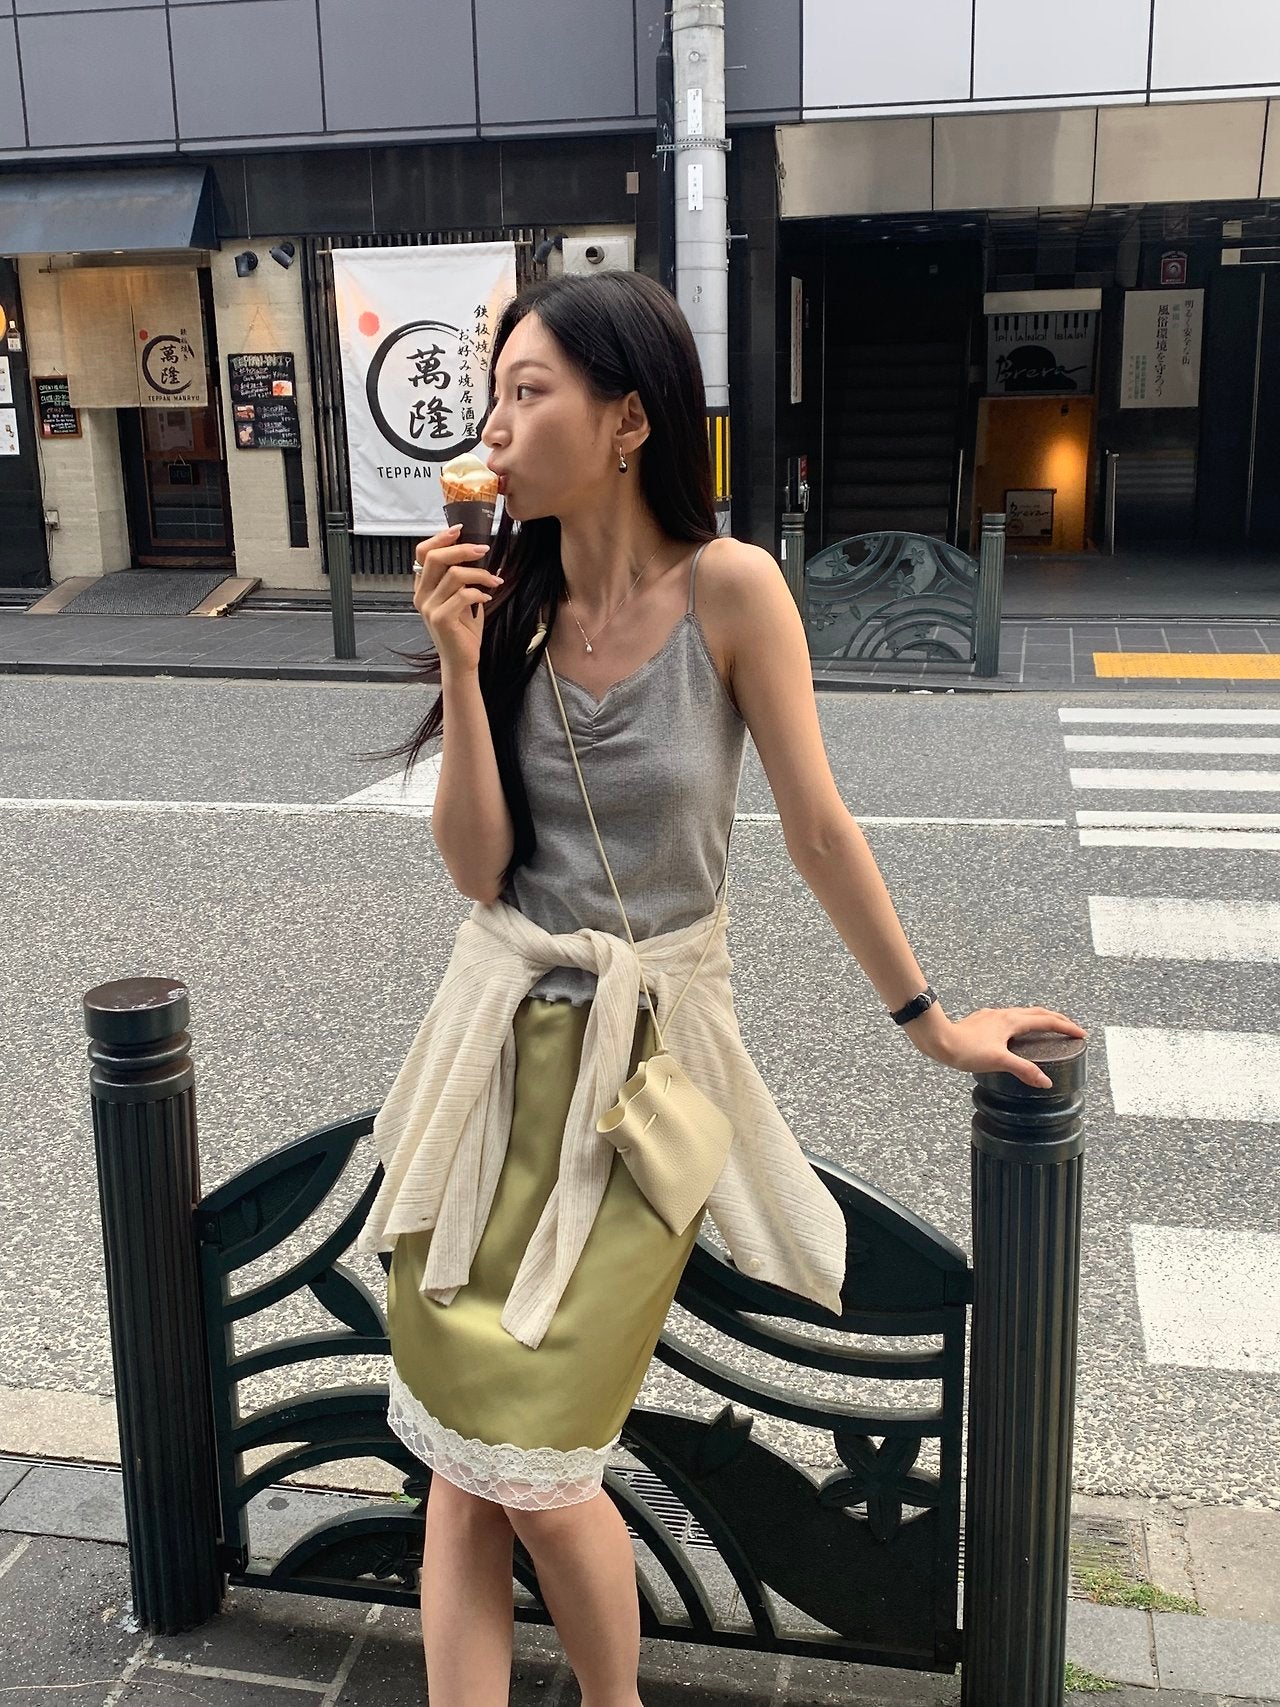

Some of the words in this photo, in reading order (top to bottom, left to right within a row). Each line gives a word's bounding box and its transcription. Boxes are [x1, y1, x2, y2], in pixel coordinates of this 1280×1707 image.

[159, 344, 181, 385] 萬隆
[474, 304, 491, 372] 鉄板焼き
[997, 334, 1046, 343] PIANO
[1154, 303, 1170, 397] 風俗環境を守ろう
[406, 343, 454, 440] 萬隆
[457, 328, 478, 438] お好み焼居酒屋
[376, 466, 432, 479] TEPPAN
